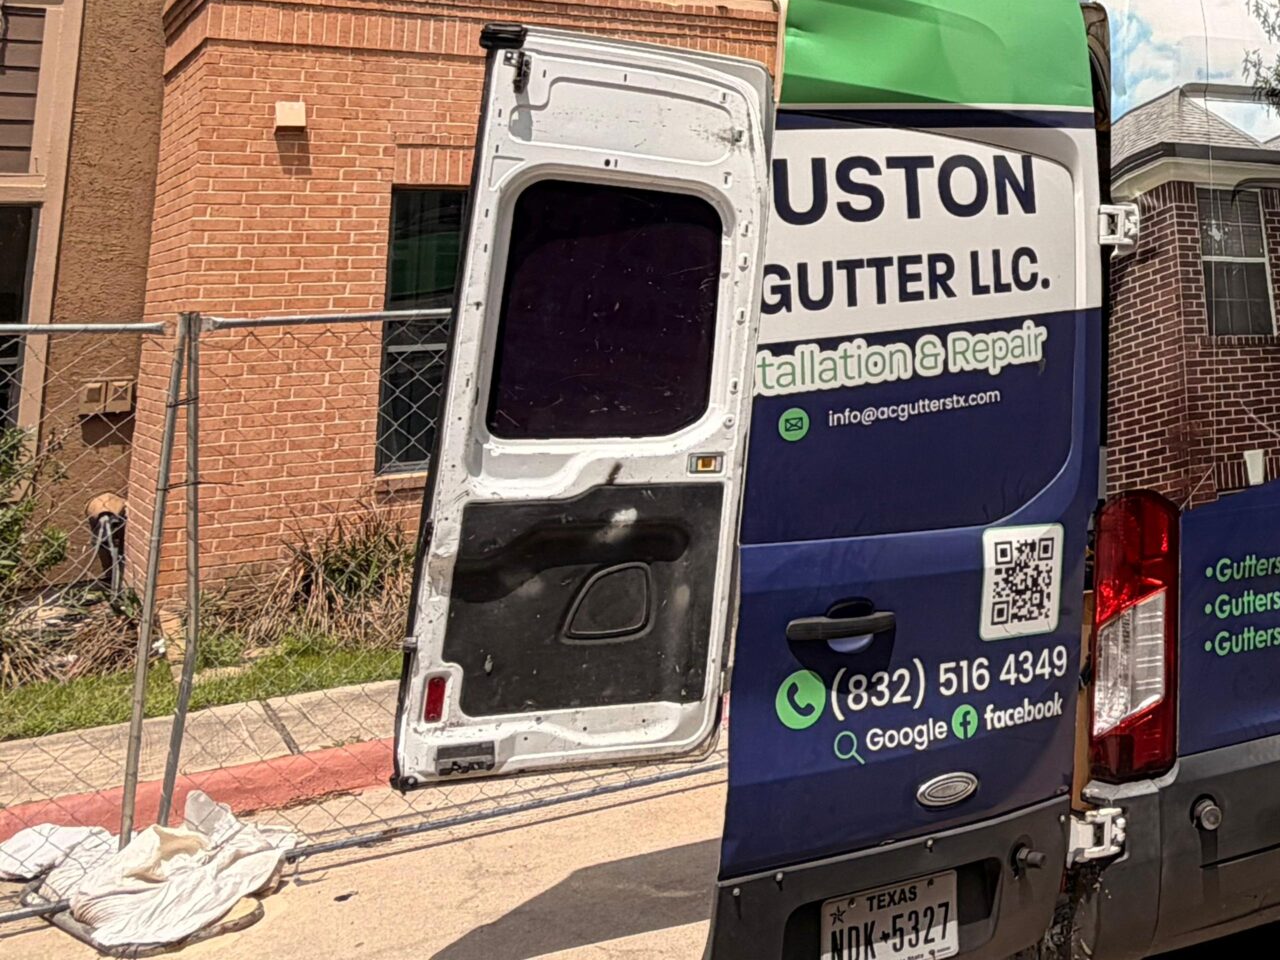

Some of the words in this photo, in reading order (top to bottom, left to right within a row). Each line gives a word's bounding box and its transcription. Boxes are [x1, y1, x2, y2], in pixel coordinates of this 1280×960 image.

[772, 154, 1037, 225] USTON
[760, 252, 958, 315] GUTTER
[971, 246, 1051, 296] LLC.
[756, 343, 909, 390] tallation
[919, 339, 941, 371] &
[952, 324, 1045, 373] Repair
[828, 388, 1001, 427] info@acgutterstx.com
[830, 657, 926, 722] (832)
[938, 656, 990, 696] 516
[999, 645, 1068, 686] 4349
[983, 691, 1064, 731] facebook
[865, 717, 948, 751] Google
[866, 885, 918, 912] TEXAS
[831, 919, 877, 960] NDK
[891, 901, 950, 953] 5327
